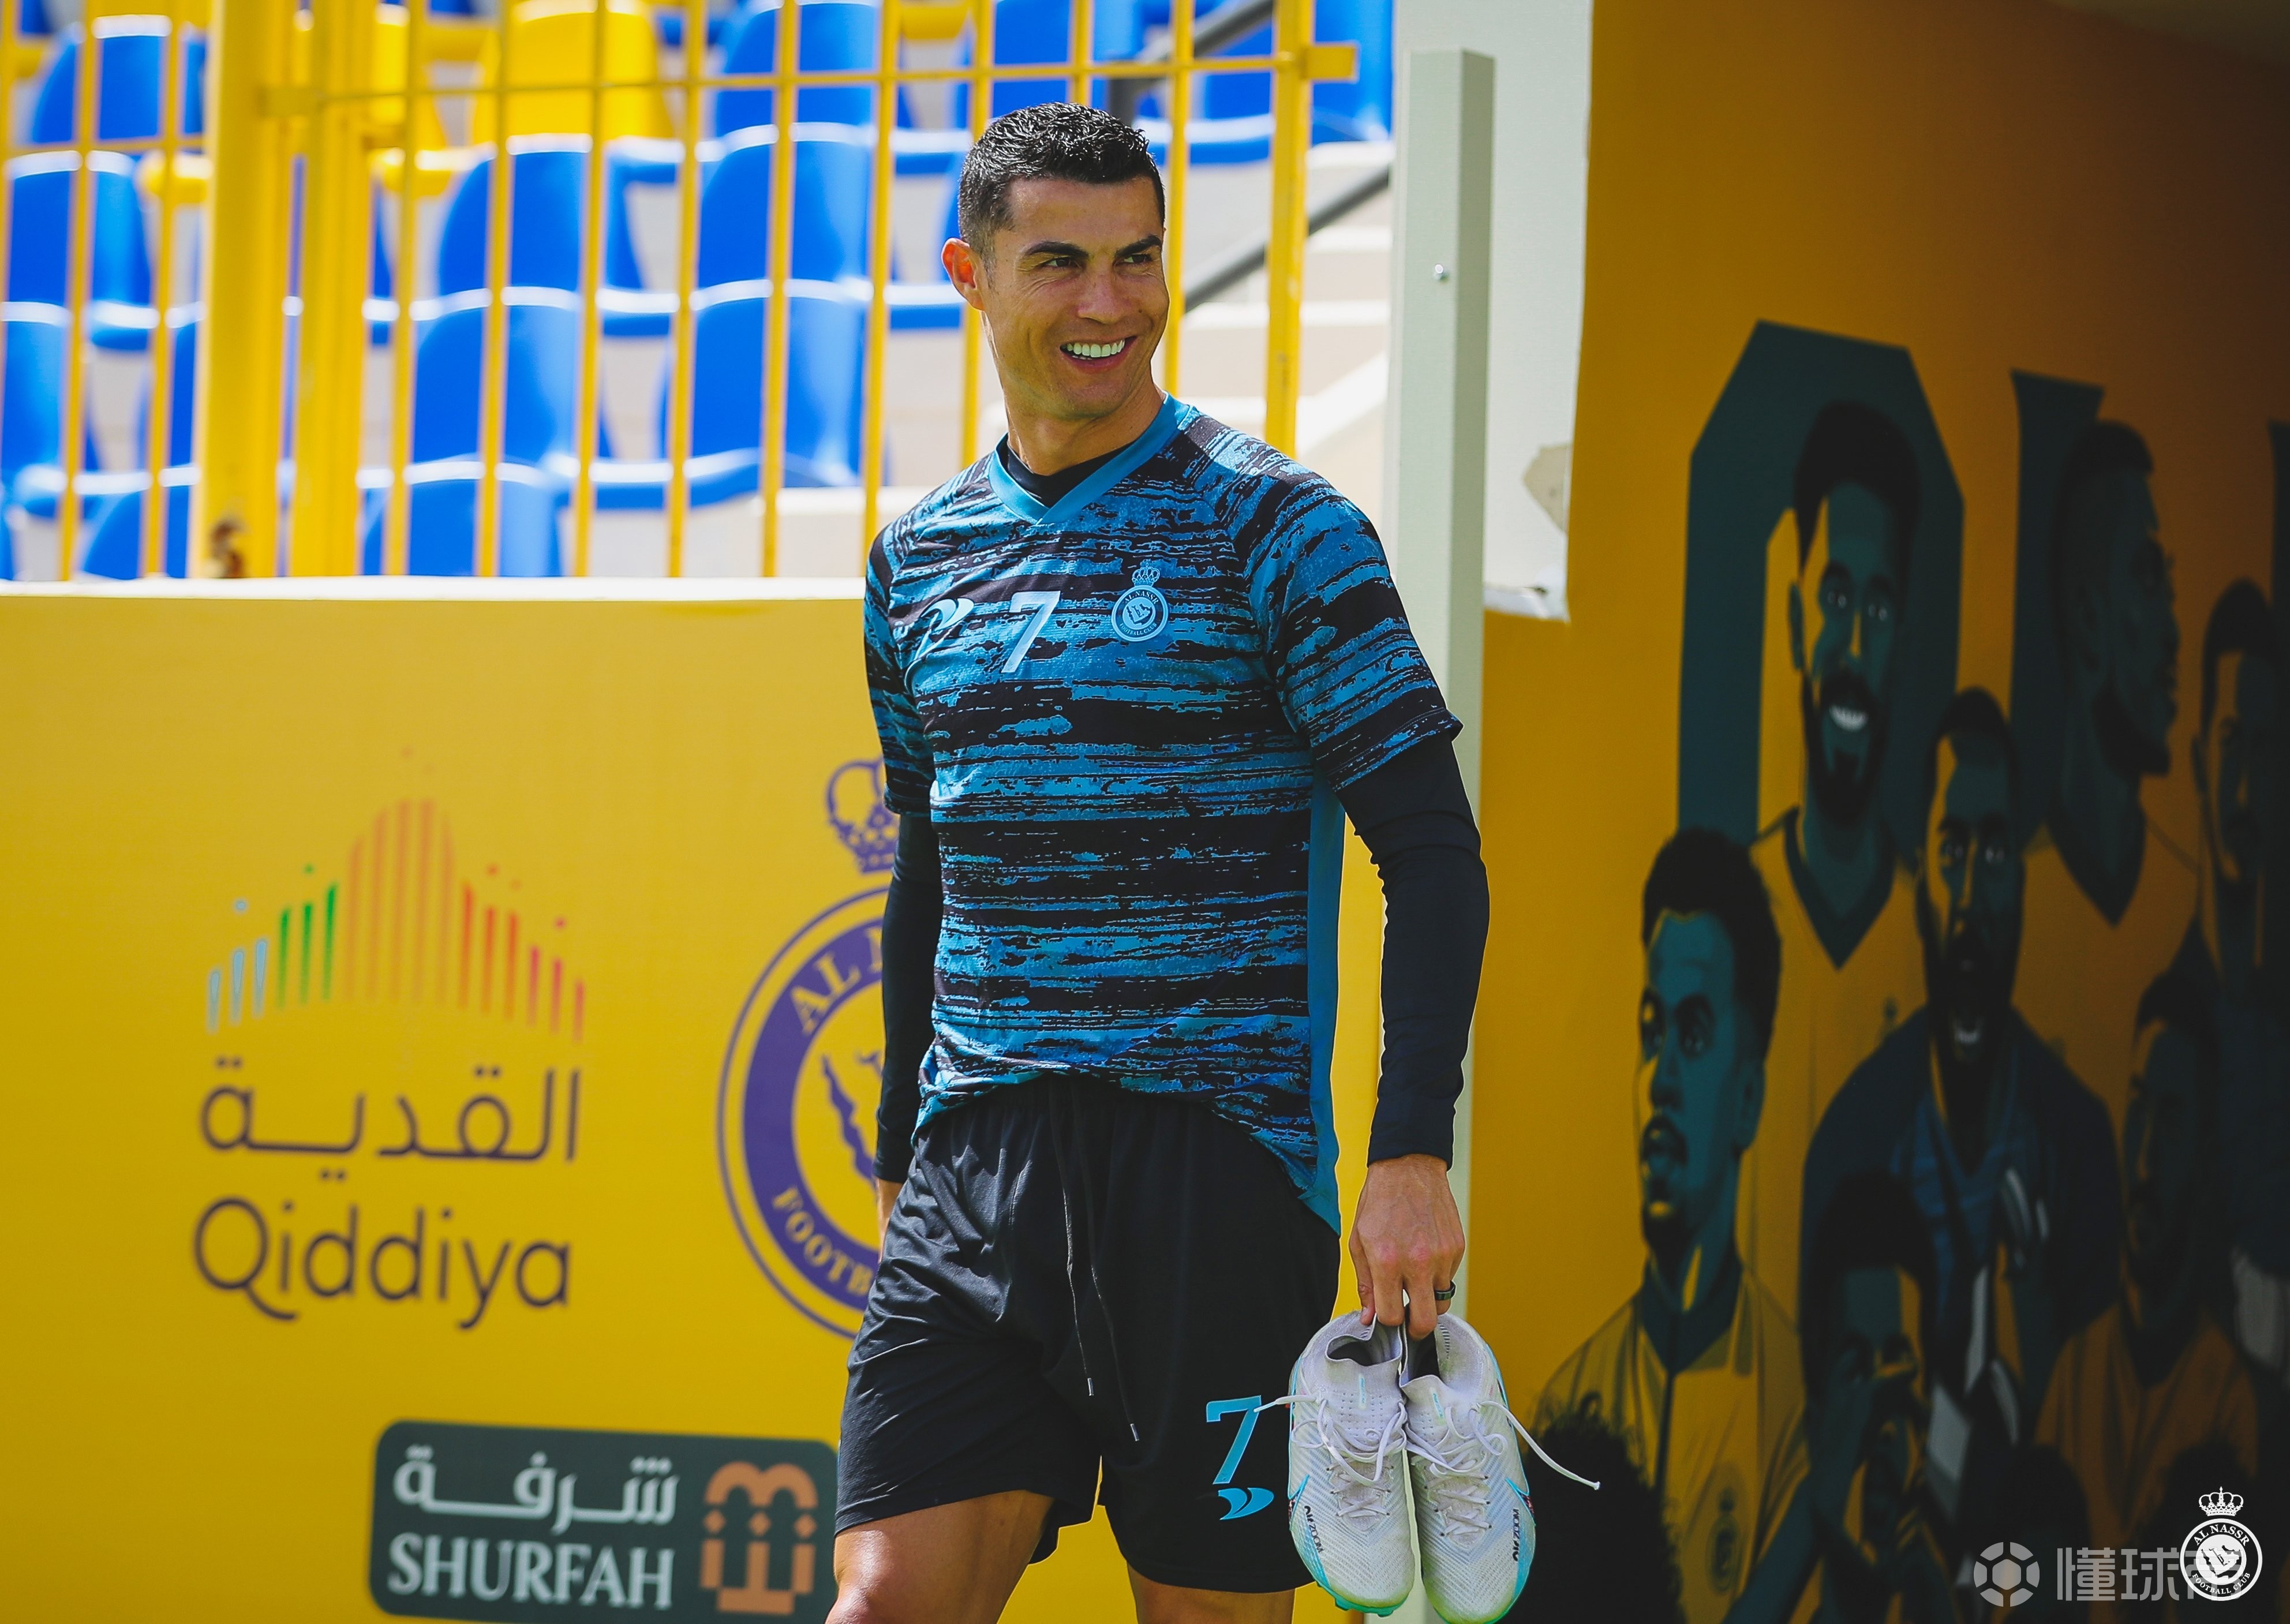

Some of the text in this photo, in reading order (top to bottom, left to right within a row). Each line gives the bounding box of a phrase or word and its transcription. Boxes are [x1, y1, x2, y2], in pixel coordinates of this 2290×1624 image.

[1001, 590, 1061, 673] 7
[1124, 590, 1159, 604] AL NASSR
[1143, 622, 1157, 633] CLUB
[791, 952, 862, 1035] AL
[199, 1055, 581, 1181] القدية
[193, 1196, 572, 1330] Qiddiya
[772, 1186, 874, 1296] FOOTB
[1206, 1395, 1262, 1485] 7
[392, 1445, 680, 1535] شرفة
[387, 1532, 675, 1610] SHURFAH
[1308, 1524, 1325, 1553] ZOOM
